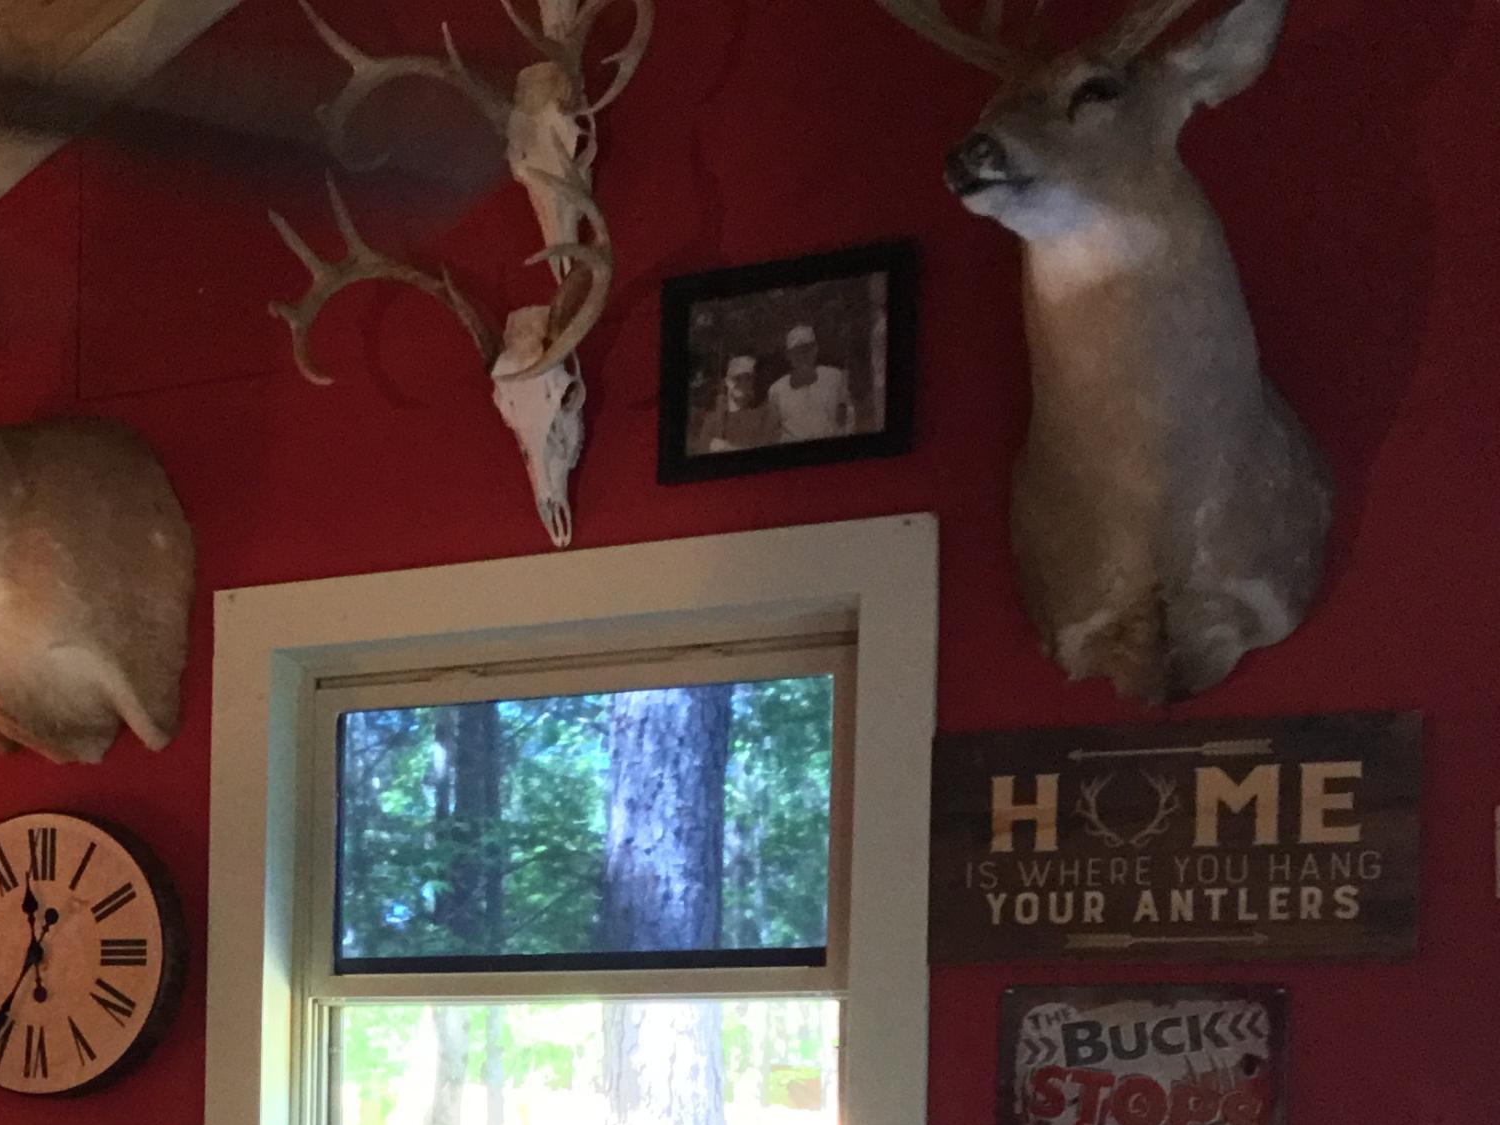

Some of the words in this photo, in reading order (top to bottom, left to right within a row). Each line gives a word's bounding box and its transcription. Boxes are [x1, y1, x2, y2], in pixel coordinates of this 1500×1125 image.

[964, 861, 998, 888] IS
[1018, 855, 1153, 887] WHERE
[1173, 852, 1249, 884] YOU
[1268, 850, 1382, 881] HANG
[985, 891, 1105, 925] YOUR
[1133, 885, 1361, 922] ANTLERS
[1062, 1010, 1229, 1066] BUCK
